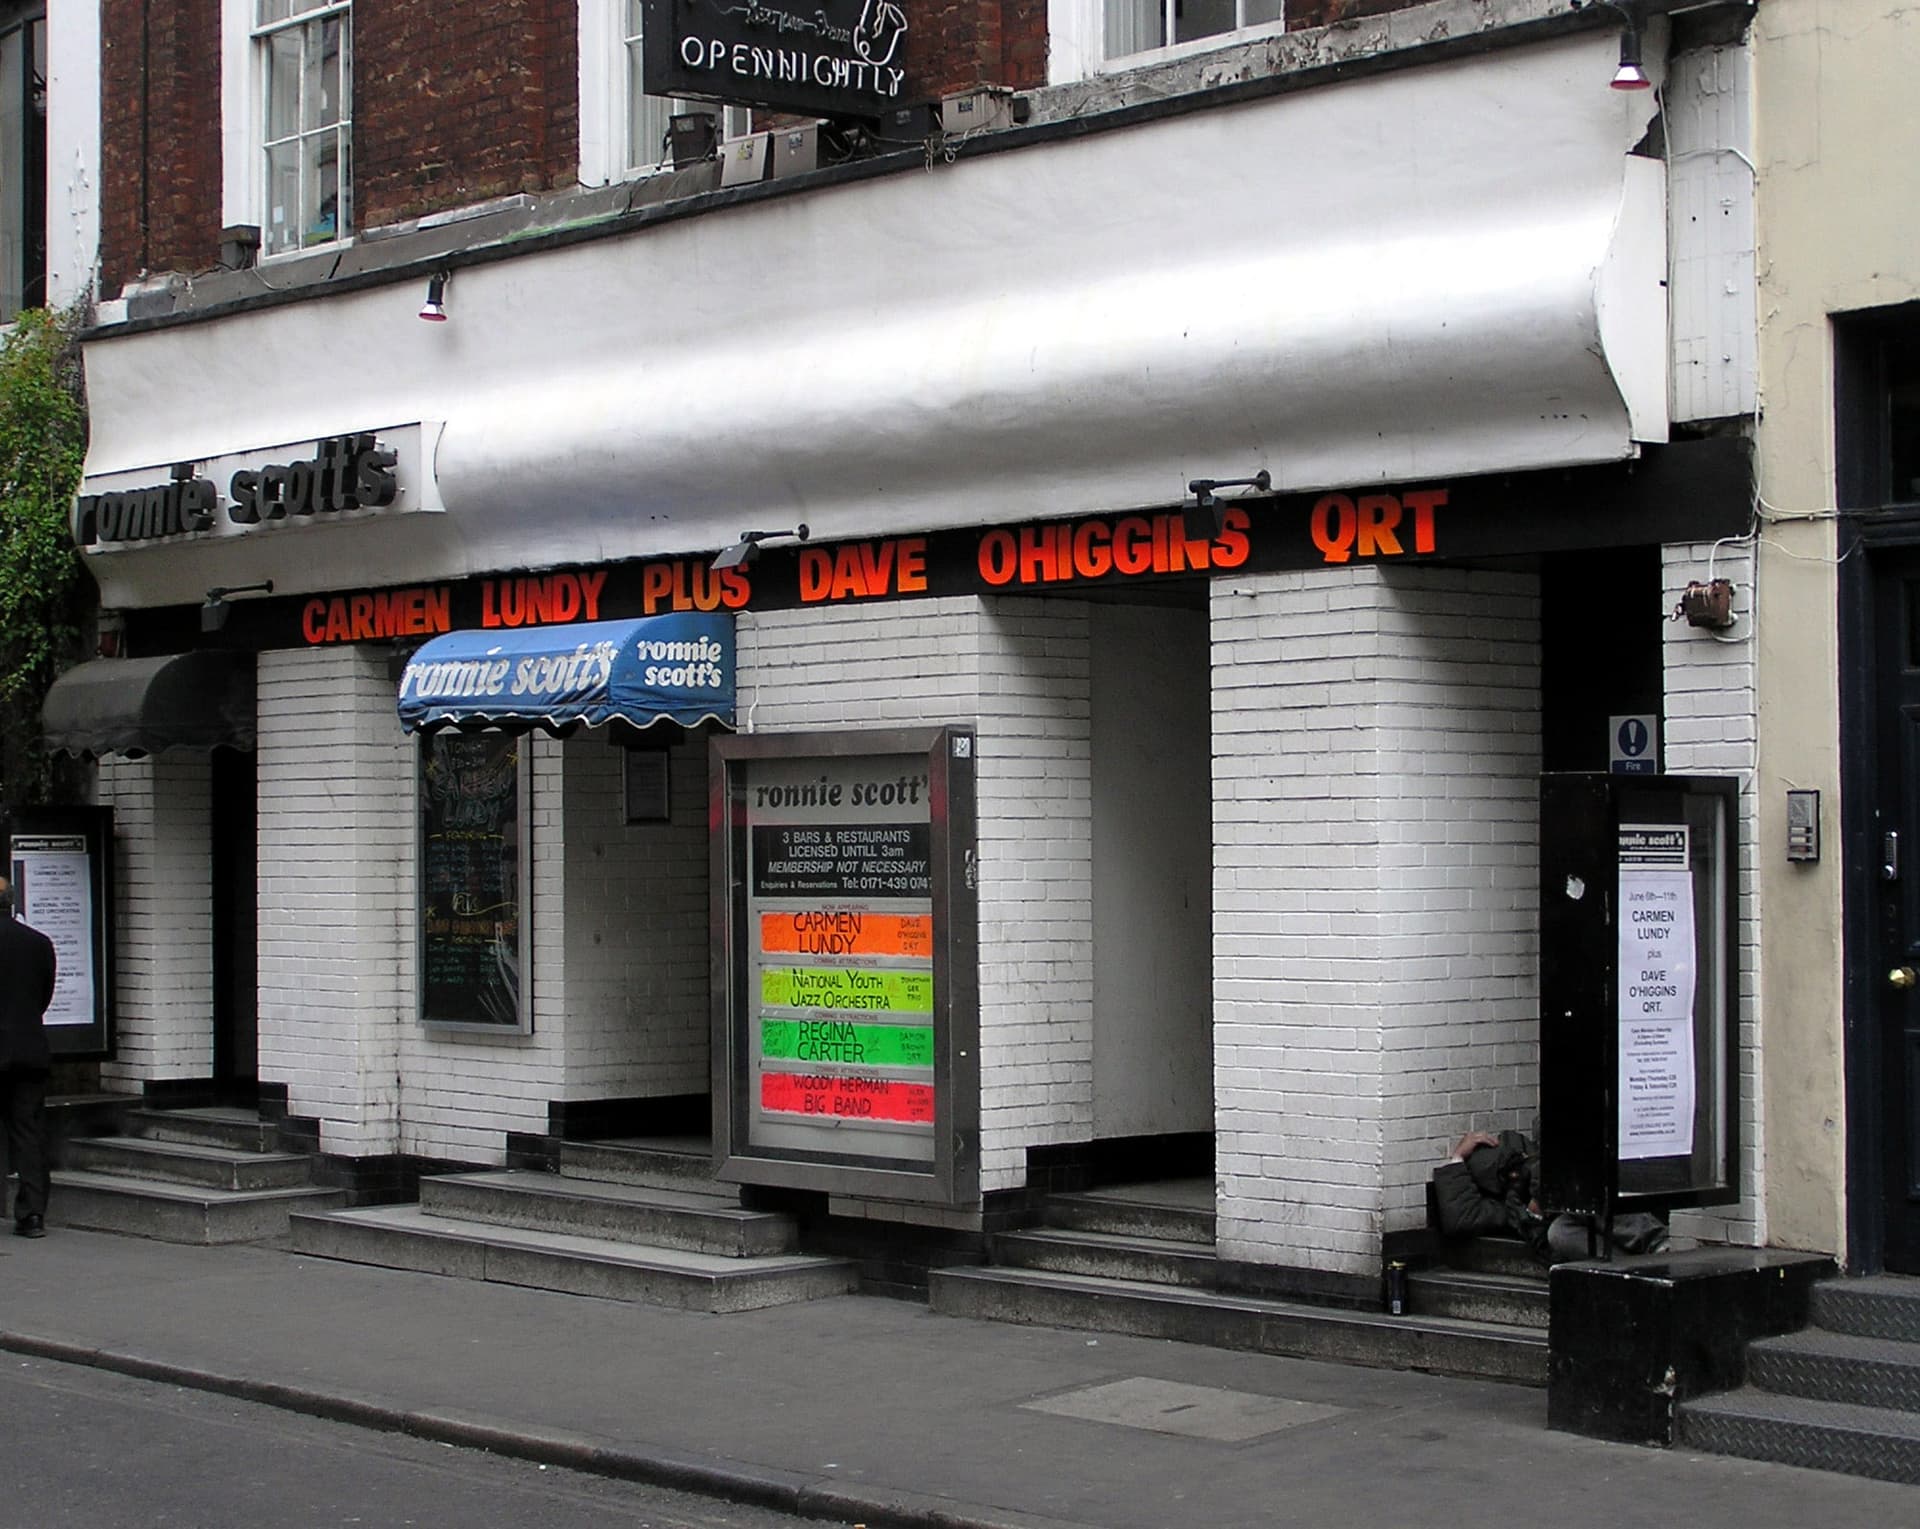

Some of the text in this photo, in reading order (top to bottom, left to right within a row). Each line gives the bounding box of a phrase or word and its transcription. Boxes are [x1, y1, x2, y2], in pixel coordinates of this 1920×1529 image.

[77, 433, 398, 545] ronnie scott's
[303, 489, 1449, 644] CARMEN LUNDY PLUS DAVE OHIGGINS QRT
[637, 636, 723, 663] ronnie
[400, 646, 505, 698] ronnie
[644, 662, 722, 688] scott's
[756, 775, 931, 808] ronnie scott'
[782, 830, 911, 844] 3 BARS & RESTAURANTS
[788, 845, 839, 858] LICENSED
[881, 845, 905, 857] 3am
[767, 860, 927, 874] MEMBERSHIP NOT NECESSARY
[793, 911, 862, 934] CARMEN
[1632, 910, 1675, 922] CARMEN
[1637, 927, 1671, 940] LUNDY
[799, 934, 857, 955] LUNDY
[793, 968, 843, 989] NATIONAL
[846, 969, 884, 990] YOUTH
[1641, 970, 1667, 982] DAVE
[790, 990, 891, 1010] JAZZ ORCHESTRA
[1629, 985, 1677, 998] O'HIGGINS
[799, 1020, 857, 1042] REGINA
[797, 1042, 865, 1063] CARTER
[793, 1075, 835, 1090] WOODY
[839, 1078, 889, 1095] HERMAN
[804, 1095, 872, 1115] BIG BAND
